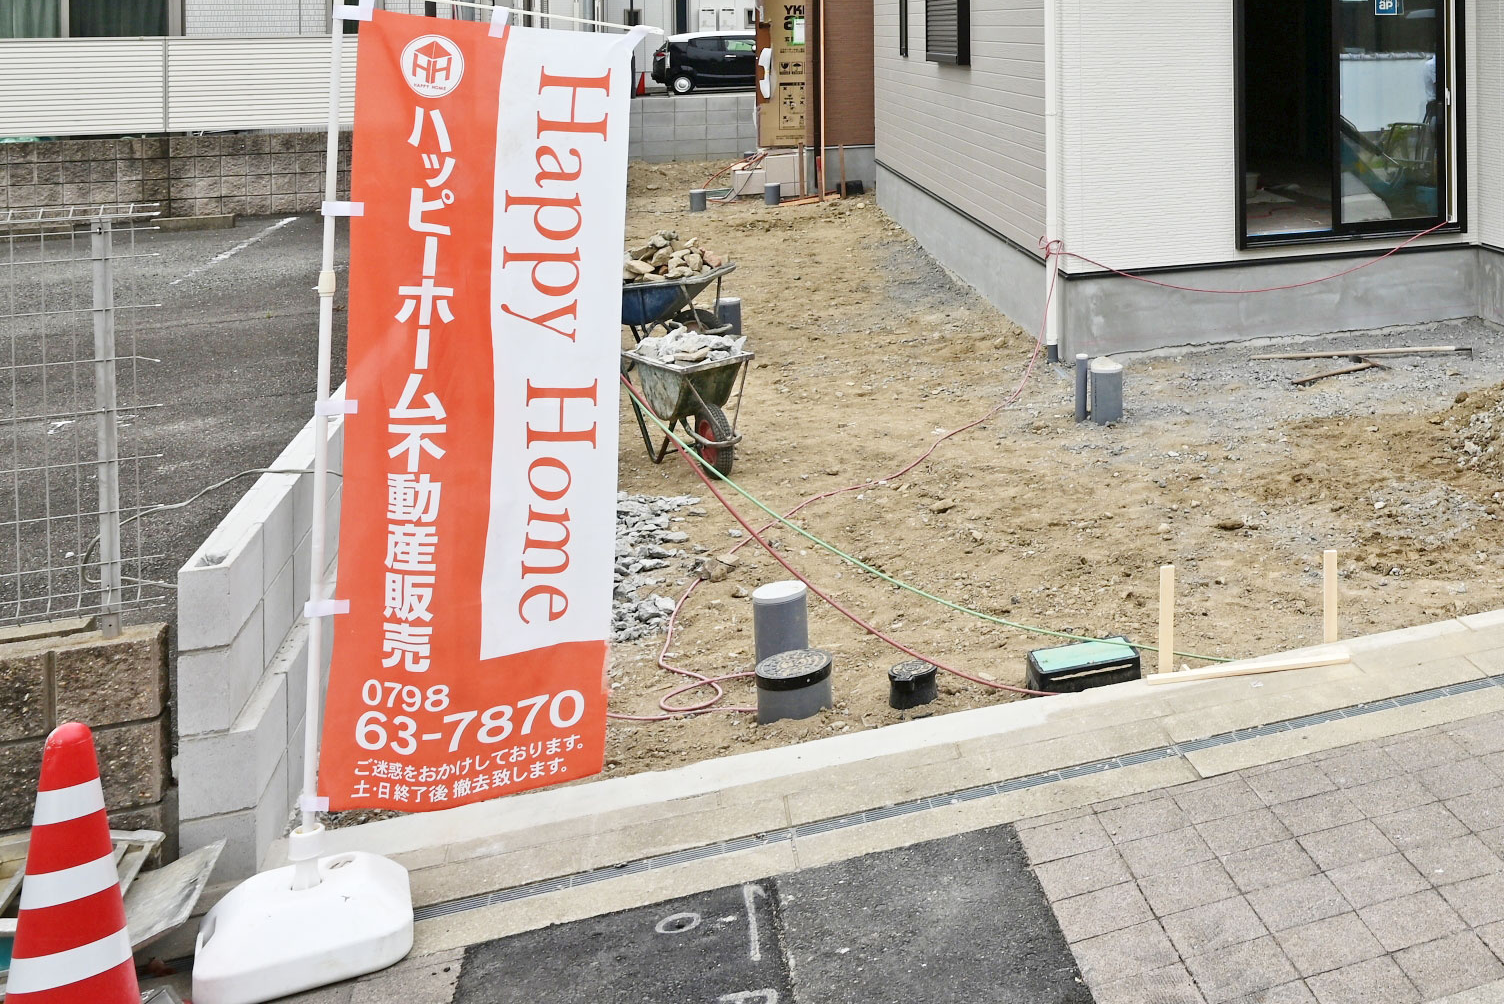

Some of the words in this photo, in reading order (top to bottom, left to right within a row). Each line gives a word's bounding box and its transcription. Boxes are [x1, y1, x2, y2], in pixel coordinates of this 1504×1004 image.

[1379, 1, 1393, 10] ap
[500, 65, 612, 343] Happy
[381, 105, 455, 673] ハッピーホーム不動産販売
[517, 377, 599, 625] Home
[355, 689, 585, 756] 63-7870
[361, 678, 450, 713] 0798
[354, 734, 584, 783] ご迷惑をおかけしております。
